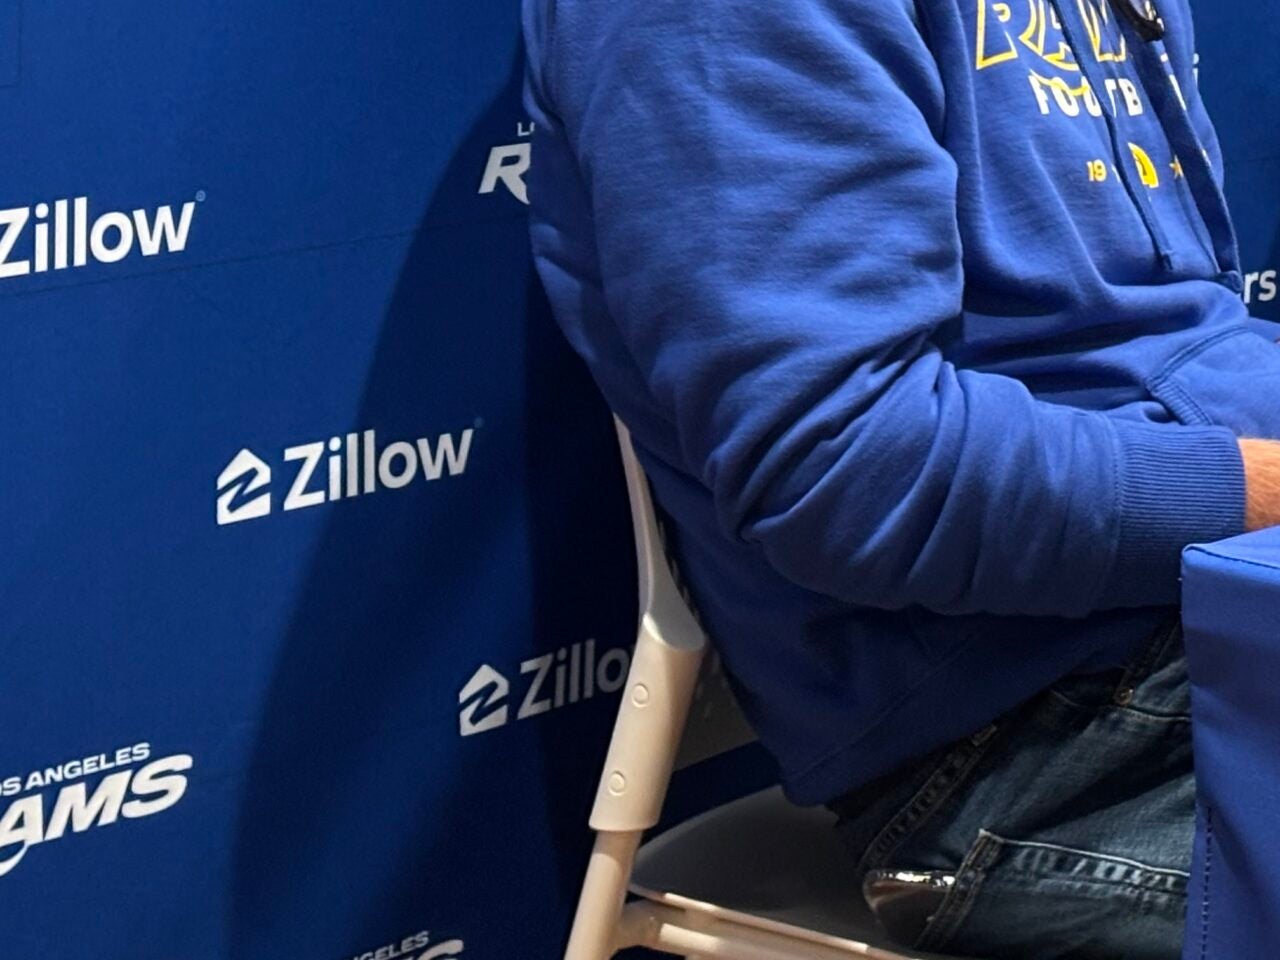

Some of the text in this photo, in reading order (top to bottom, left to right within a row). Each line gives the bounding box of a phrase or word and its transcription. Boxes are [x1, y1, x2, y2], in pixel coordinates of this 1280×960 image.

[283, 429, 473, 511] Zillow
[516, 638, 632, 720] Zillo
[25, 742, 150, 790] ANGELES
[0, 754, 193, 876] AMS
